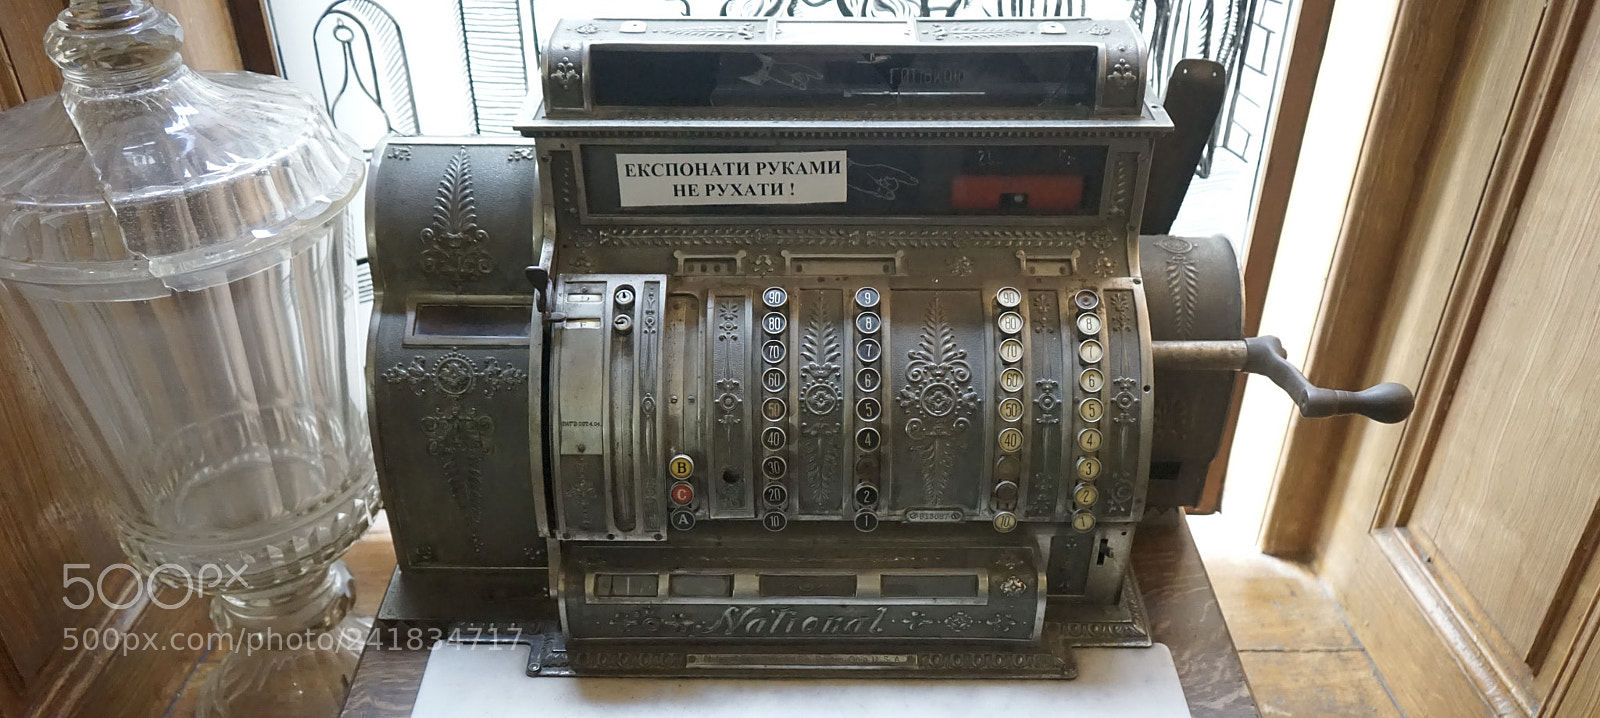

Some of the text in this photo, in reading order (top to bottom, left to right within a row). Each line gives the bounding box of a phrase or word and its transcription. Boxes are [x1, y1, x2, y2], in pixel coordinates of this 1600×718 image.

[625, 159, 842, 178] ЕКСПОНАТИ РУКАМИ
[673, 184, 699, 197] НЕ
[705, 182, 784, 197] РУХАТИ
[768, 291, 781, 304] 90
[1003, 291, 1015, 304] 90
[769, 317, 781, 331] 80
[768, 345, 780, 359] 70
[1006, 344, 1018, 358] 70
[768, 372, 780, 387] 60
[1005, 372, 1018, 388] 60
[768, 403, 780, 417] 50
[1005, 403, 1018, 418] 50
[767, 431, 780, 446] 40
[1004, 433, 1017, 448] 40
[767, 460, 780, 475] 30
[768, 487, 780, 502] 20
[770, 515, 780, 527] 10
[1001, 515, 1011, 528] 10
[694, 606, 887, 635] National
